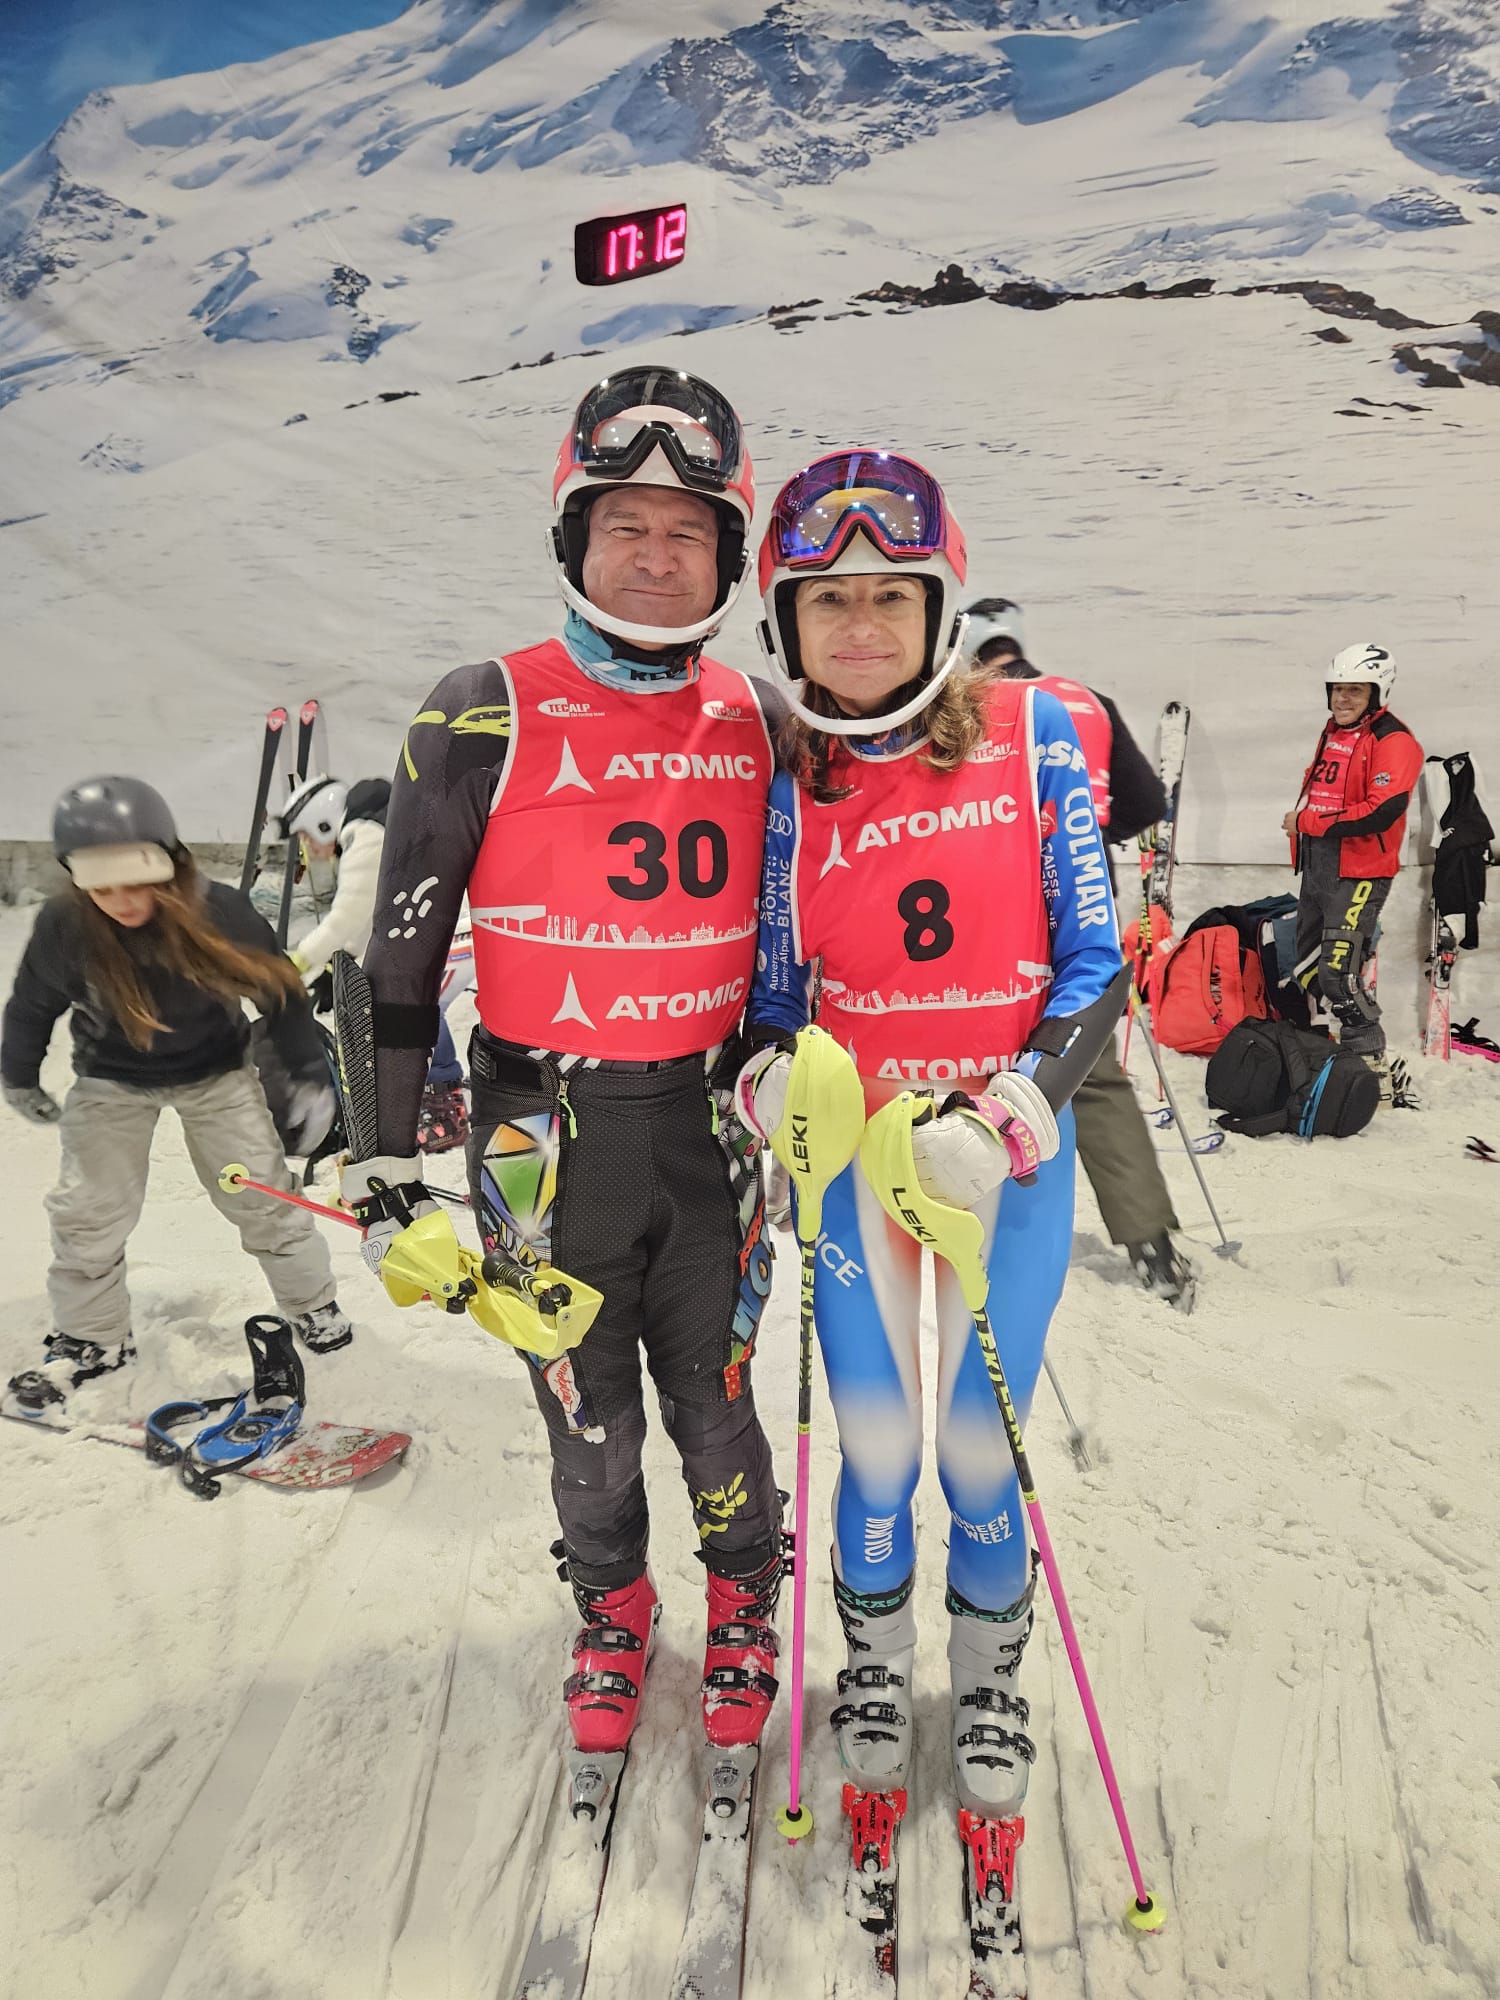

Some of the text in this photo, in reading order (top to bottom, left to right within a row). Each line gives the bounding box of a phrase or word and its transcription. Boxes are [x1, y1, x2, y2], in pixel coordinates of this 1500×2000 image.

[606, 208, 687, 277] 17:12
[603, 752, 757, 780] ATOMIC
[1312, 759, 1340, 784] 20
[856, 794, 1019, 853] ATOMIC
[607, 819, 729, 901] 30
[1064, 787, 1110, 930] COLMAR
[765, 870, 778, 926] MONT
[777, 859, 791, 928] BLANC
[898, 879, 954, 962] 8
[779, 932, 790, 993] hône-Alpes
[605, 977, 745, 1020] ATOMIC
[796, 1115, 810, 1174] LEKI
[1015, 1126, 1037, 1167] LEKI
[892, 1187, 938, 1243] LEKI
[801, 1246, 815, 1316] LEKI
[973, 1311, 1003, 1382] LEKI
[963, 1522, 1013, 1544] WEEZ
